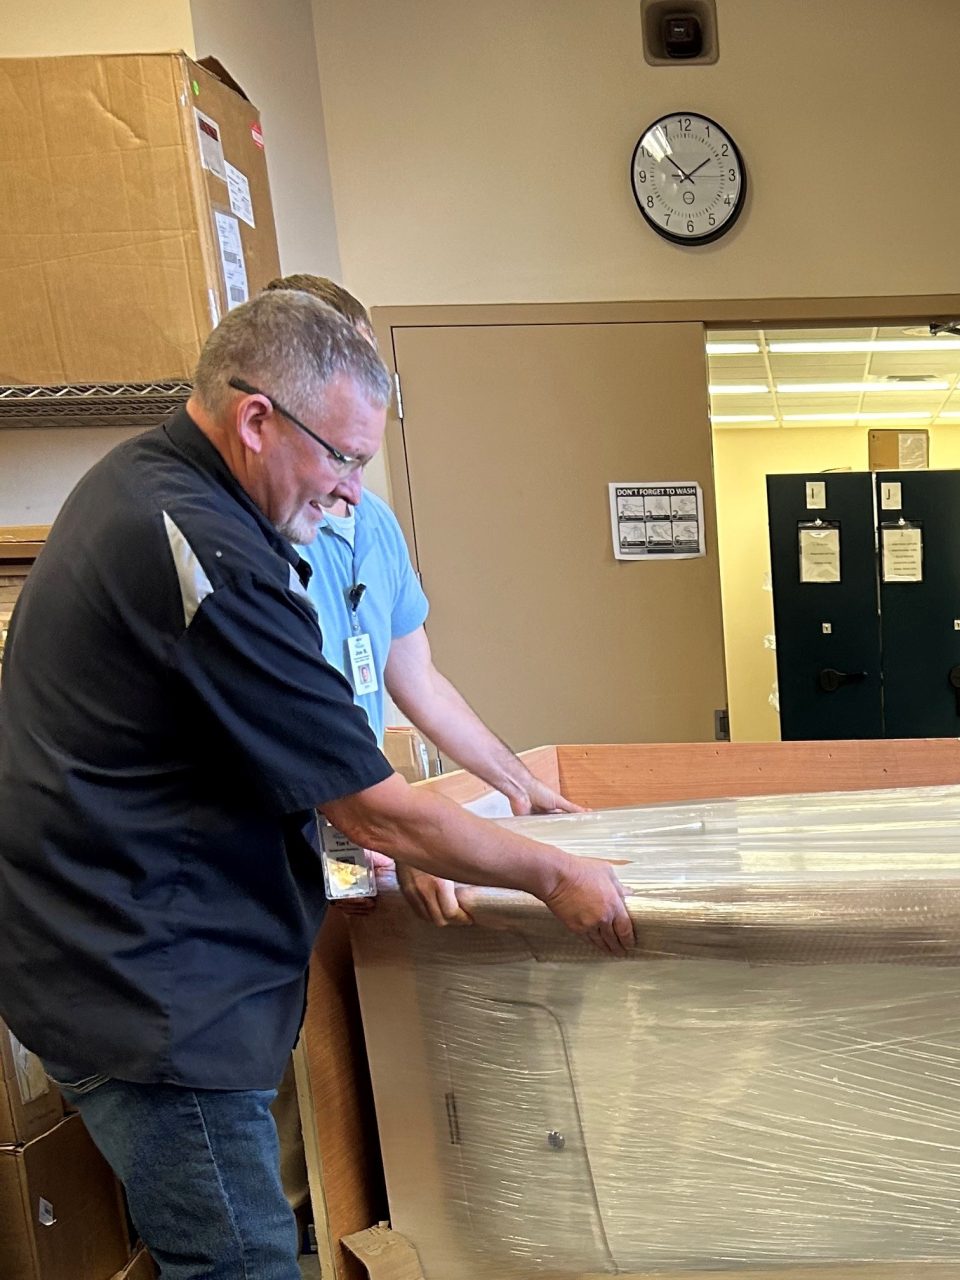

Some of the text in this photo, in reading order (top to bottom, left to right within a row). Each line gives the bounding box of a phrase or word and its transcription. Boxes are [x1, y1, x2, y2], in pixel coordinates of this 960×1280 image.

[677, 118, 692, 132] 12
[705, 126, 711, 138] 1
[721, 144, 729, 157] 2
[639, 171, 647, 183] 9
[728, 168, 736, 182] 3
[646, 196, 654, 208] 8
[723, 194, 732, 207] 4
[664, 214, 671, 227] 7
[708, 212, 716, 226] 5
[686, 220, 694, 233] 6
[617, 488, 638, 496] DON'T
[640, 488, 665, 496] FORGET
[676, 487, 696, 495] WASH
